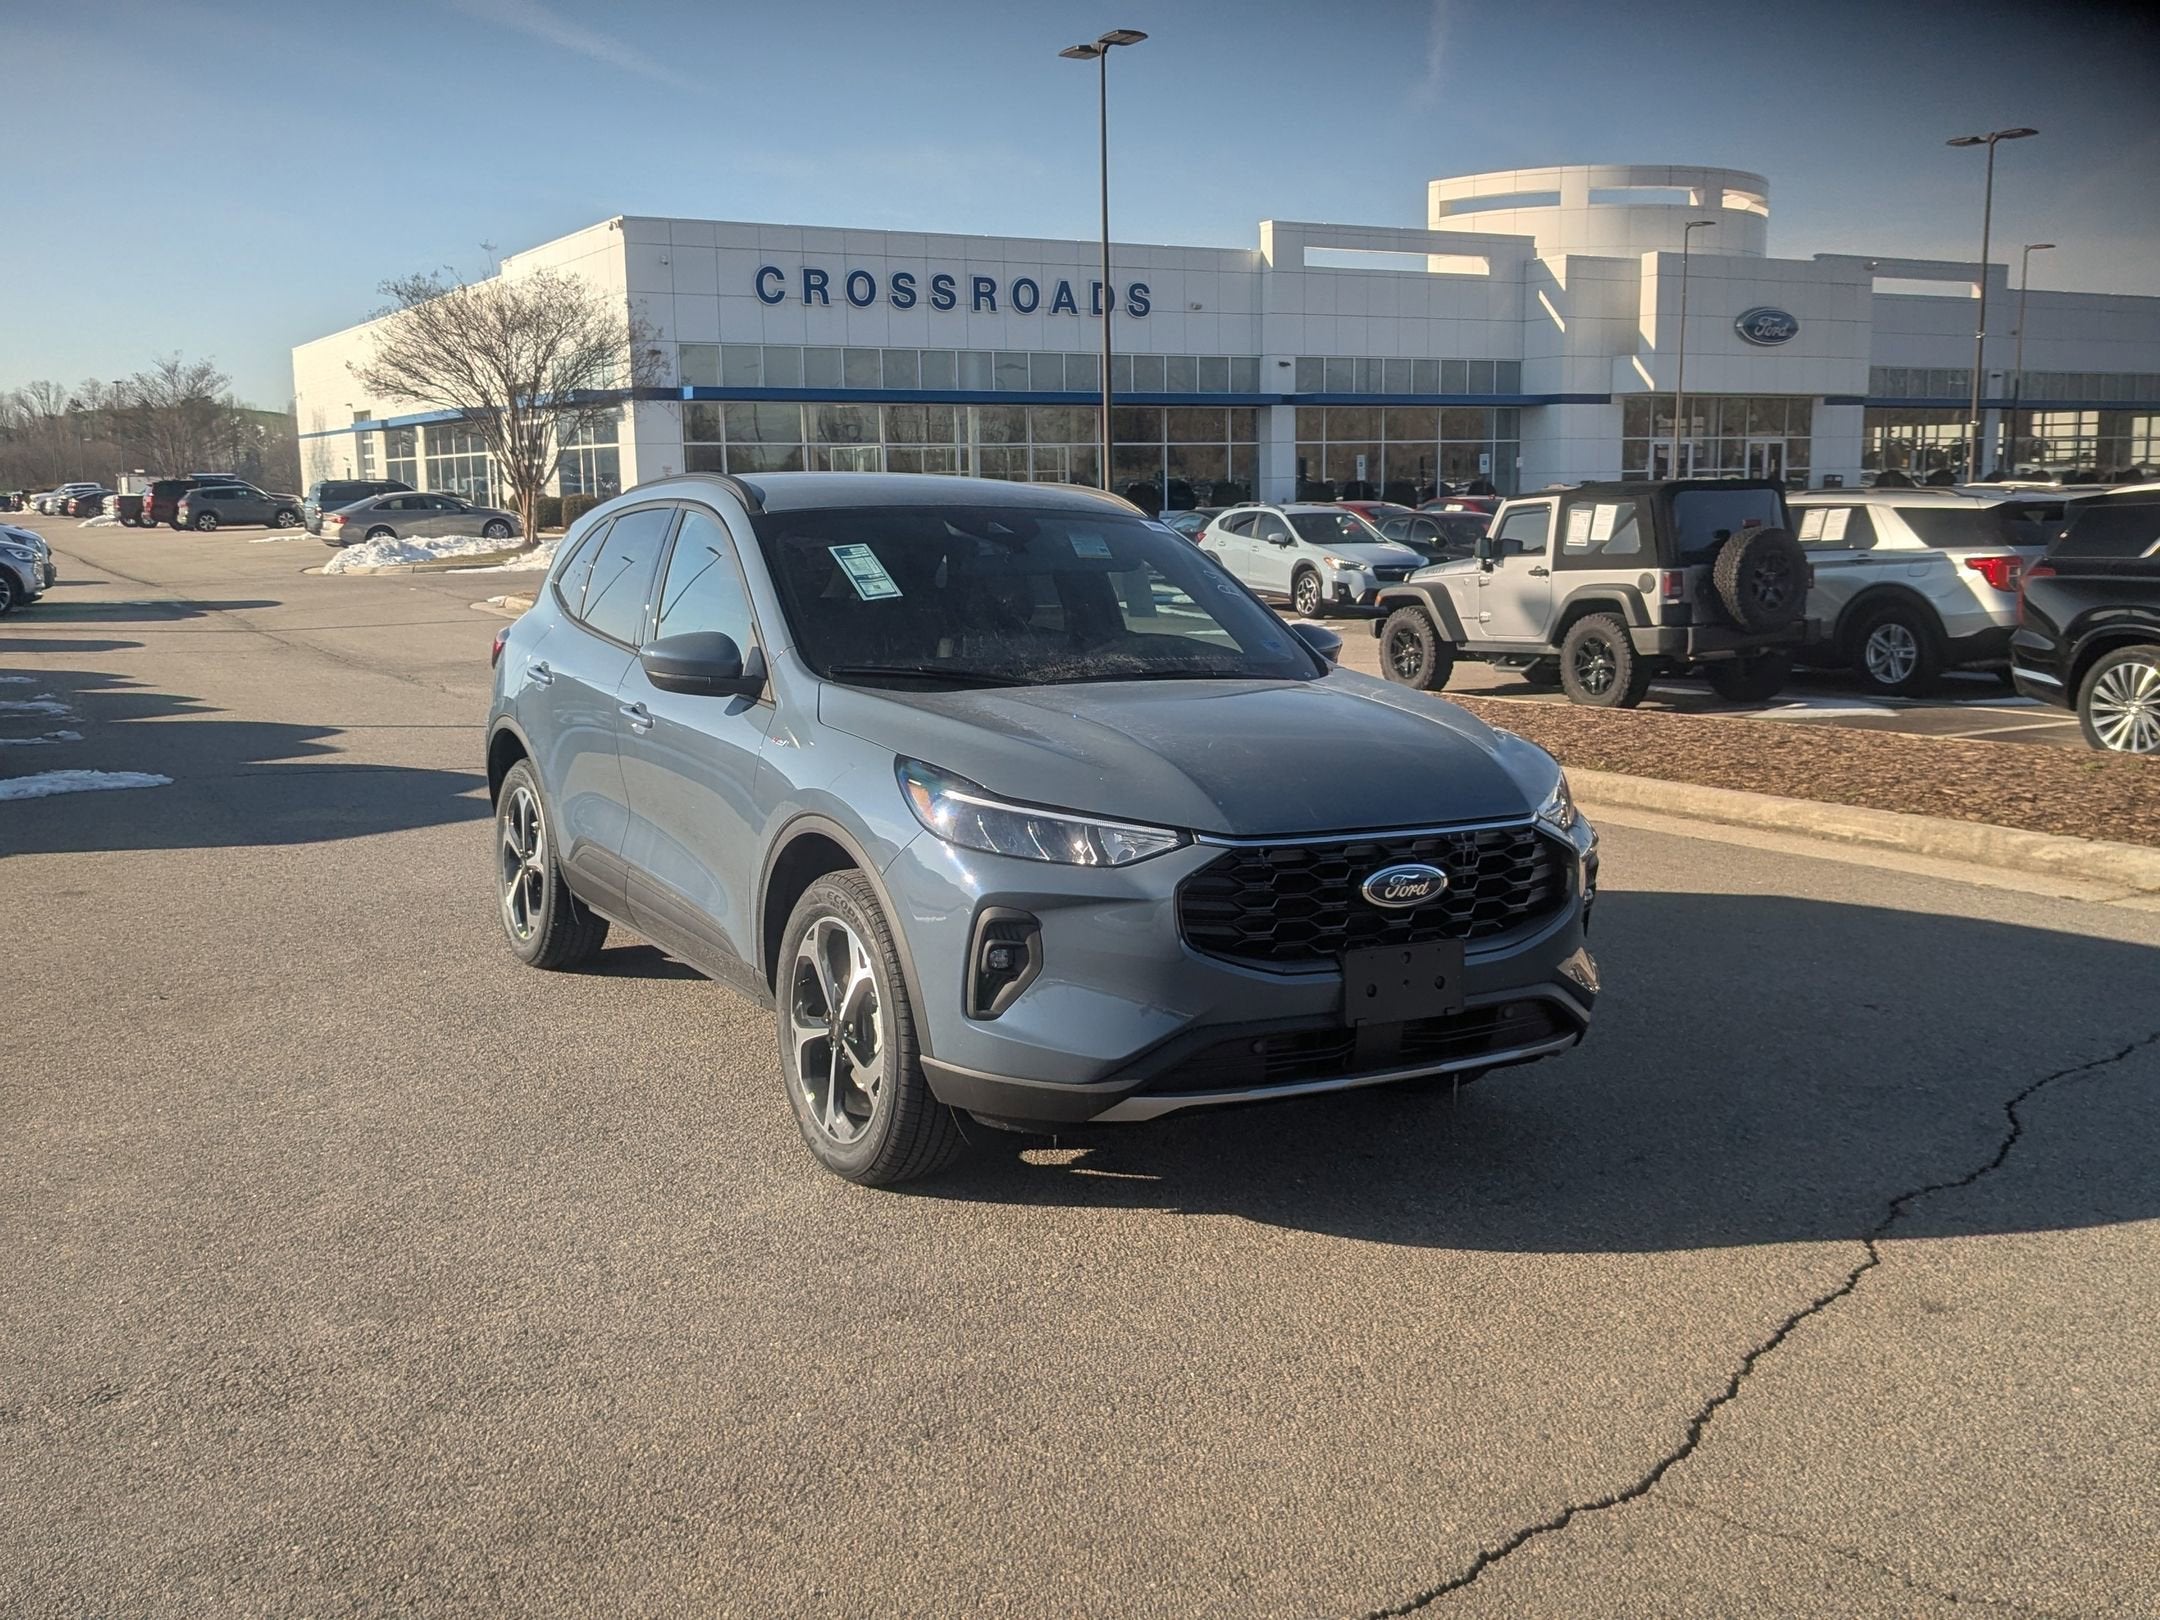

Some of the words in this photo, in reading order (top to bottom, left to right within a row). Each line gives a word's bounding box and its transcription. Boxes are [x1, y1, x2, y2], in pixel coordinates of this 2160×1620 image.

[755, 265, 1151, 318] CROSSROADS
[1754, 316, 1791, 337] Ford
[1385, 873, 1431, 899] Ford
